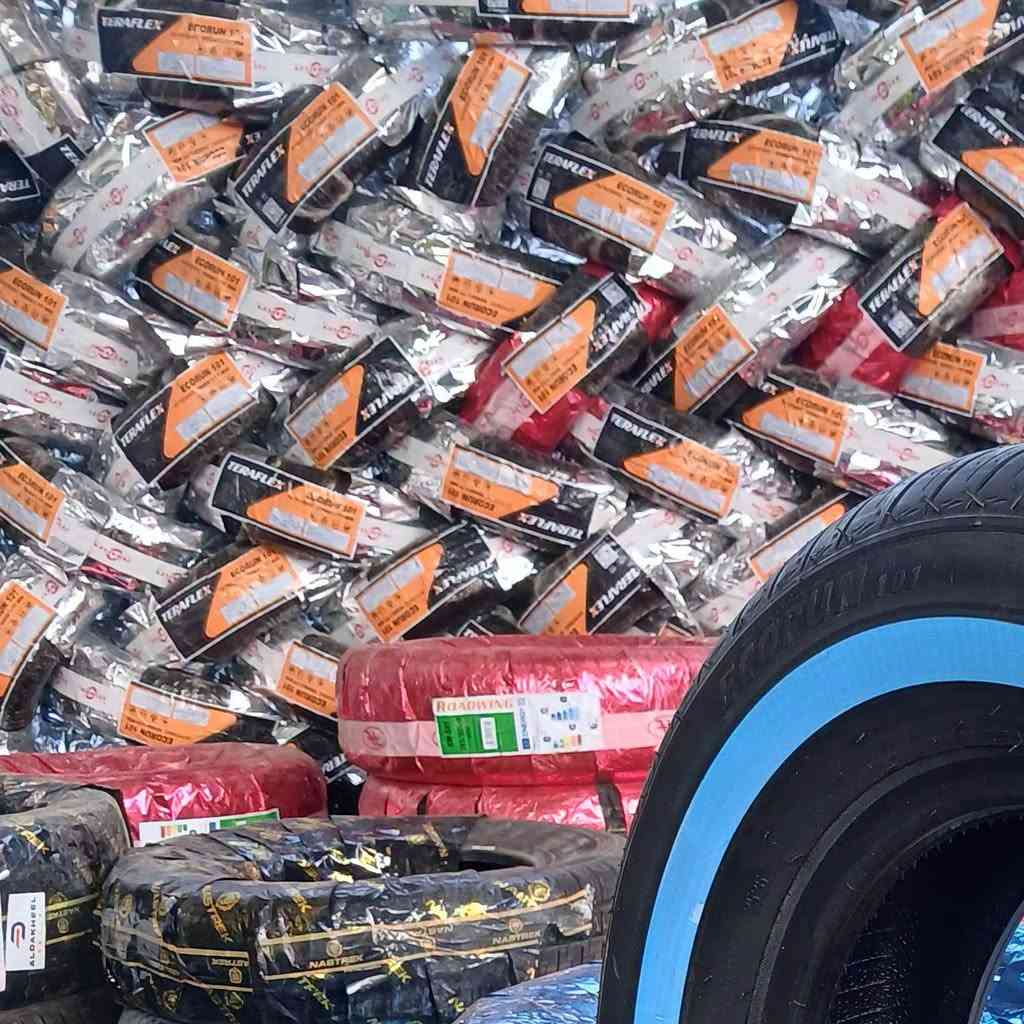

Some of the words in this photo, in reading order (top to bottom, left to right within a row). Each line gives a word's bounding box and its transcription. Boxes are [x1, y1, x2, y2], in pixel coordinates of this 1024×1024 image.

[242, 144, 286, 197] TERAFLEX
[0, 179, 30, 193] TERA
[120, 402, 165, 449] TERAFLEX
[227, 460, 291, 490] TERAFLEX
[520, 513, 584, 540] TERAFLEX
[161, 584, 212, 621] TERAFLEX
[589, 567, 640, 619] TERAFLEX
[436, 699, 513, 713] ROADWING
[28, 896, 36, 967] ALDAKHEEL
[492, 931, 540, 944] NASTREK
[310, 957, 364, 968] NASTREK
